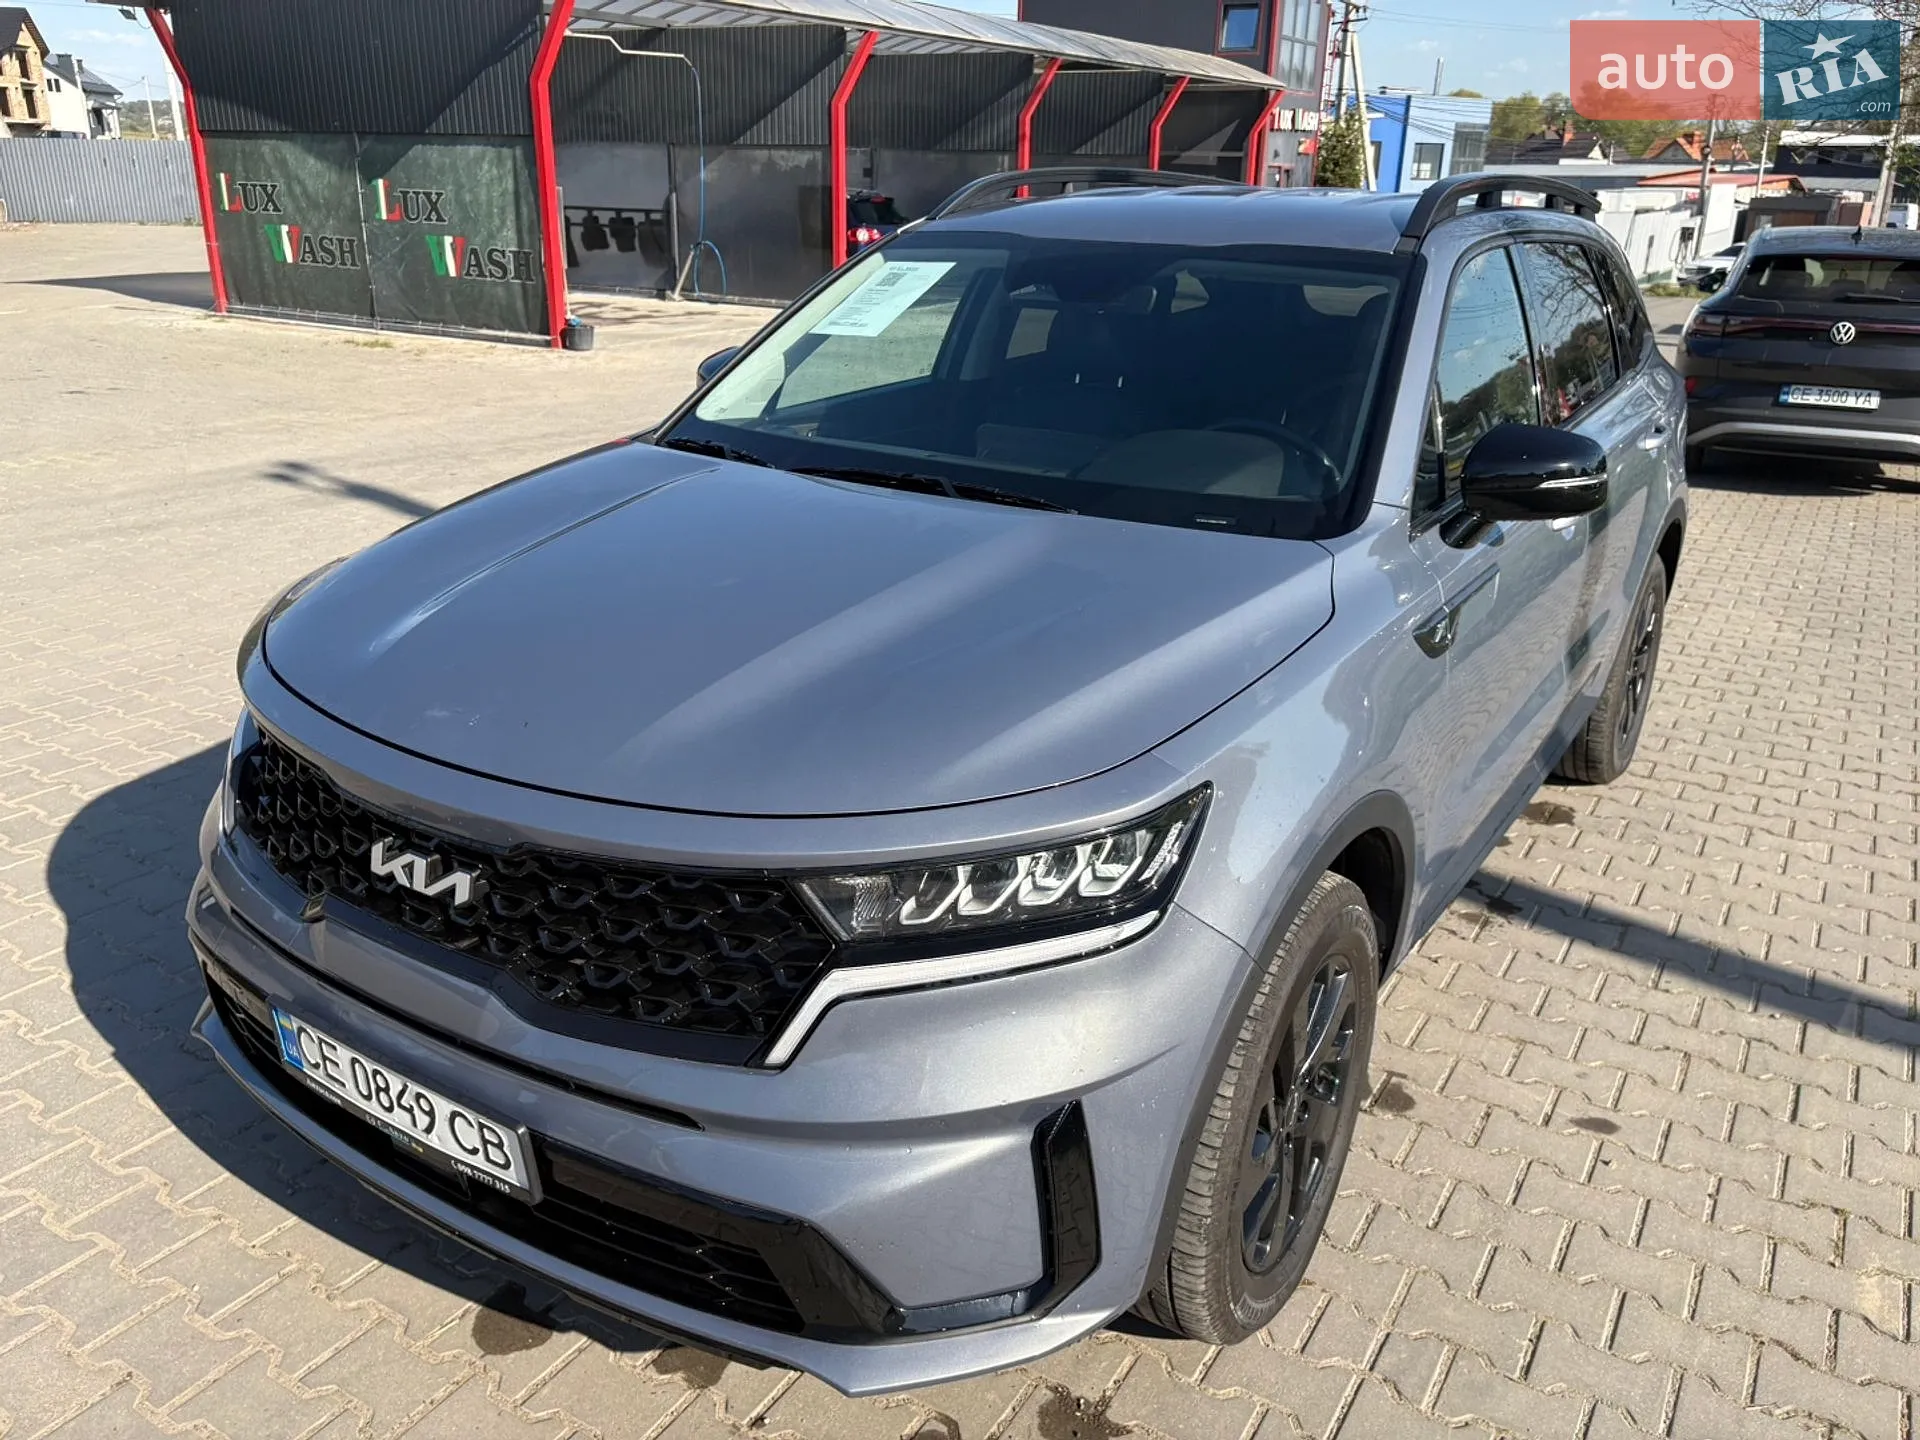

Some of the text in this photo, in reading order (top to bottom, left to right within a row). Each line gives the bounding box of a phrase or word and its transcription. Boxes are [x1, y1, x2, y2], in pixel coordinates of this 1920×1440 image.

[1791, 387, 1873, 406] CE 3500 YA
[297, 1026, 346, 1089] CE
[351, 1055, 437, 1136] 0849
[450, 1110, 512, 1170] CB
